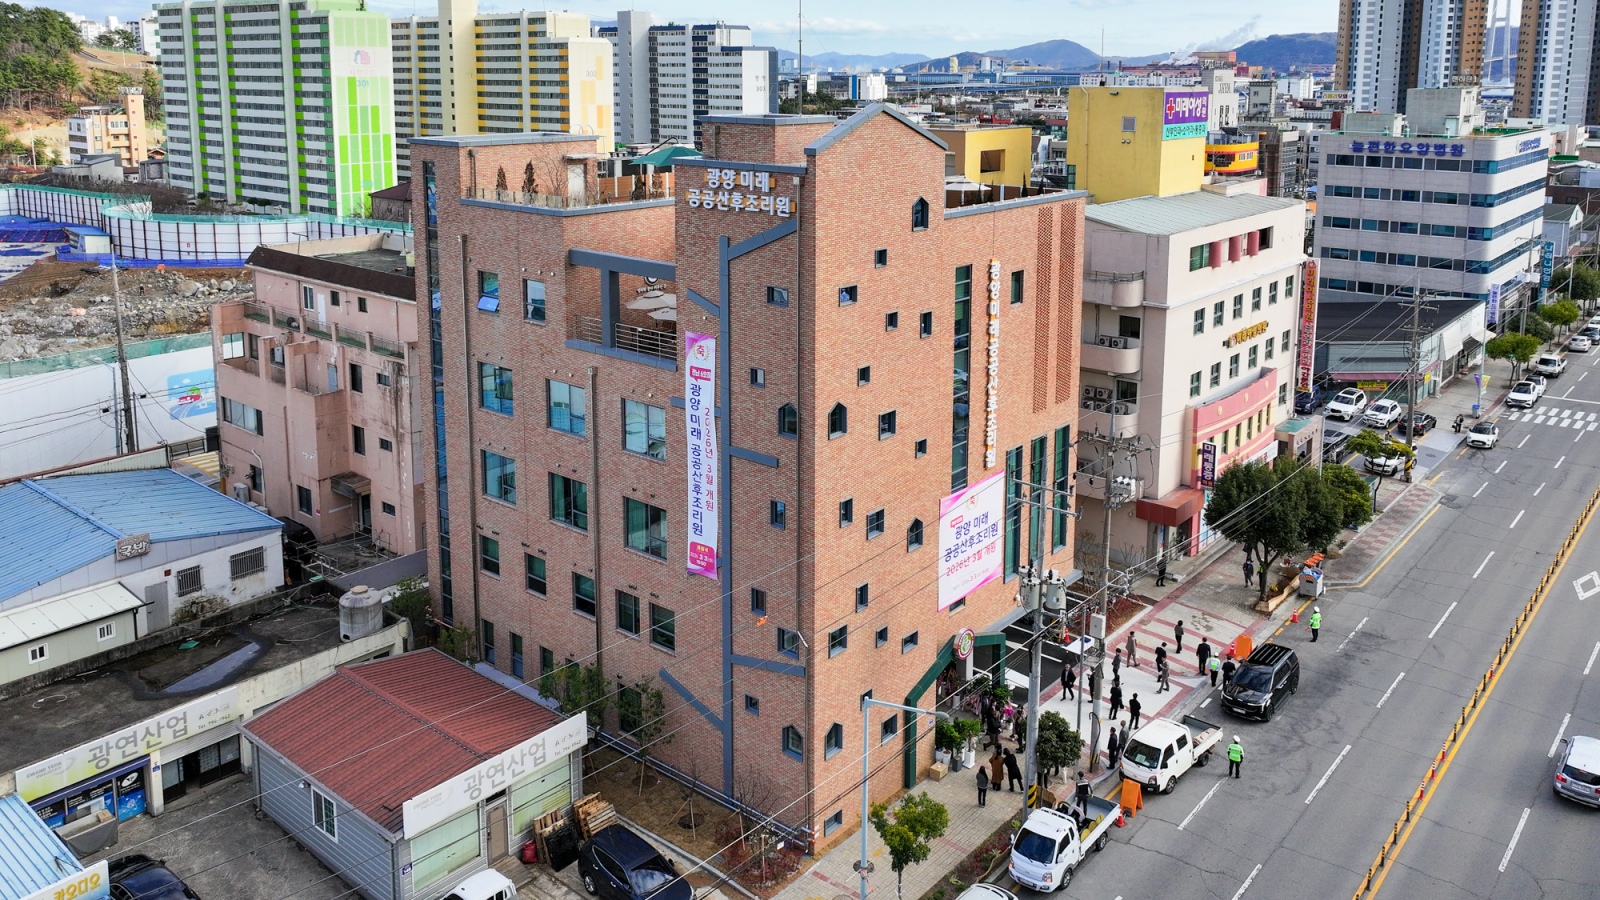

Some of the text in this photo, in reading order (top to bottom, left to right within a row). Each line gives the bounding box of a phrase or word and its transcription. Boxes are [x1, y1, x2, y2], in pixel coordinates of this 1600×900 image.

[356, 79, 369, 87] 301
[1352, 140, 1464, 157] 늘편한요양병원
[707, 168, 770, 193] 광양 미래
[687, 188, 790, 217] 공공산후조리원
[690, 383, 703, 537] 광양 미래 공공산후조리원
[704, 407, 714, 513] 2026년 3월 개원
[944, 521, 999, 563] 공공산후조리원
[955, 520, 971, 540] 광양
[974, 511, 989, 529] 미래
[946, 541, 997, 577] 2026년 3월 개원
[88, 711, 188, 770] 광연산업
[463, 737, 547, 801] 광연산업
